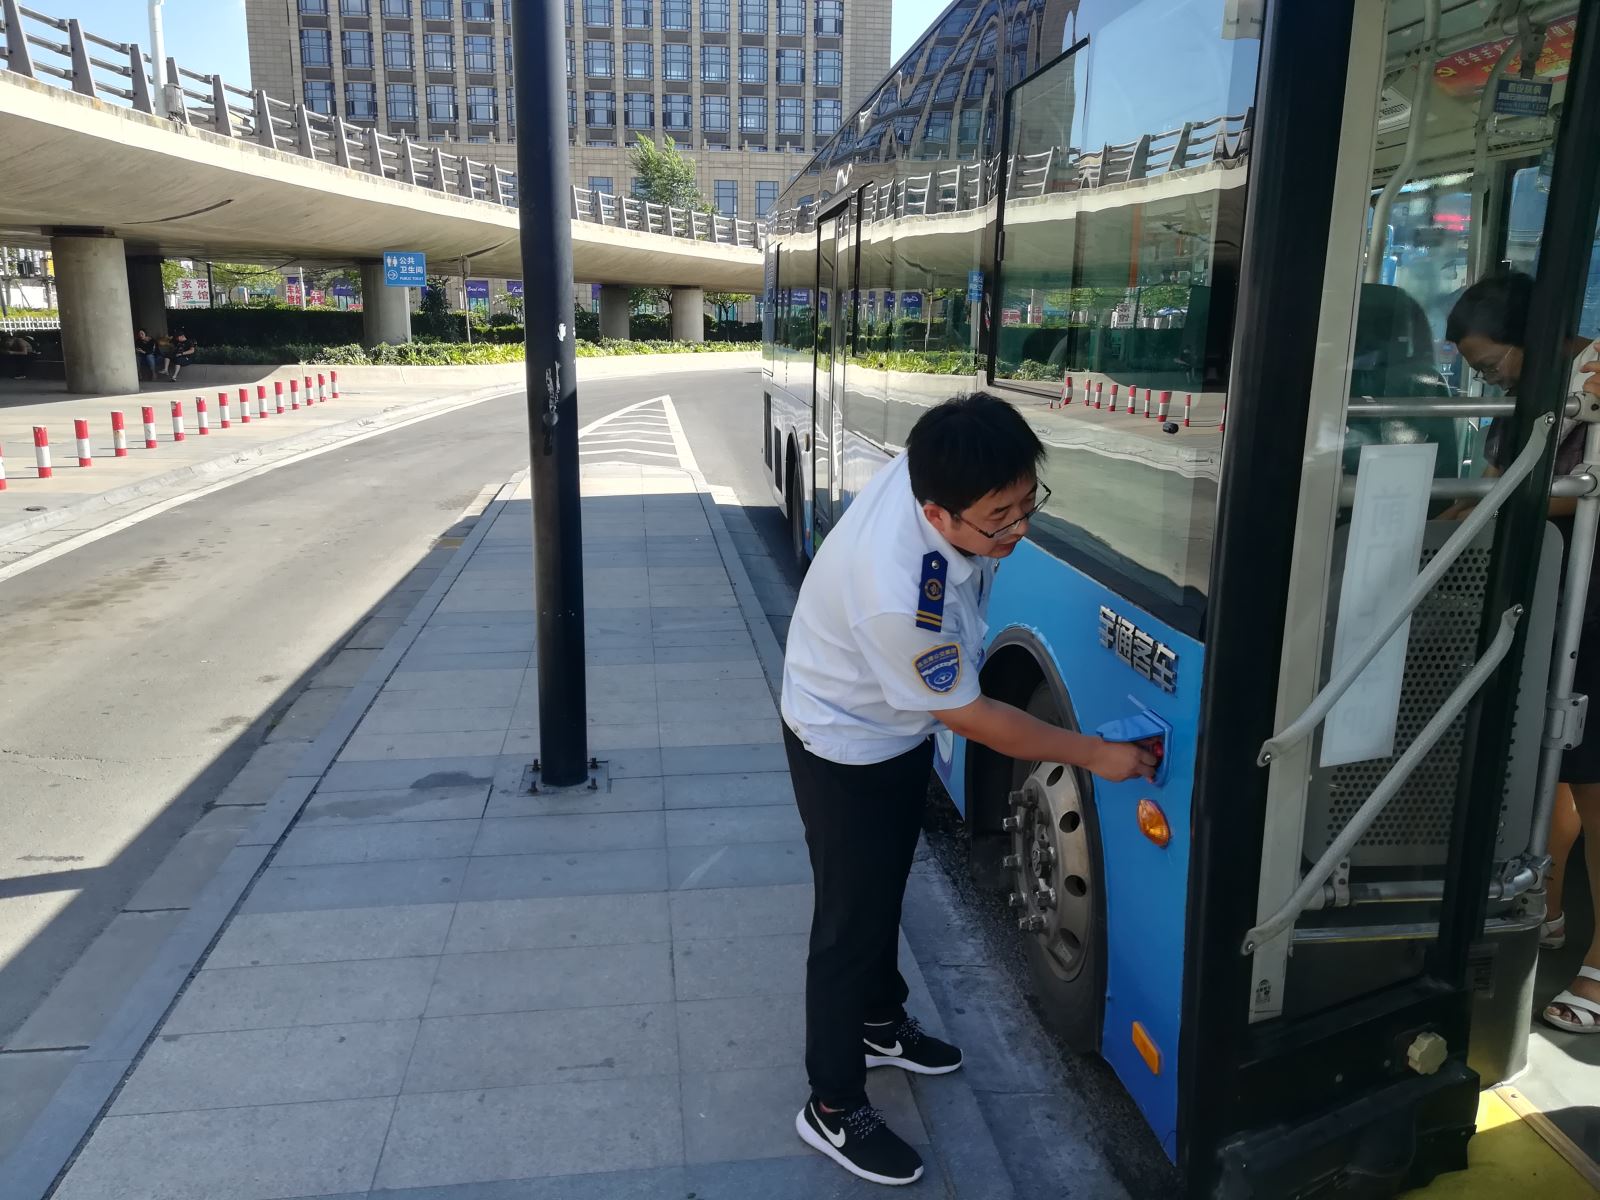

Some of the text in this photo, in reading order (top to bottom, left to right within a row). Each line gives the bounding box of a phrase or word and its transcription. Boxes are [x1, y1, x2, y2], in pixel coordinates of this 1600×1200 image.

[399, 256, 415, 265] 公共
[399, 266, 424, 274] 卫生间
[182, 279, 208, 289] 家常
[182, 290, 209, 300] 菜馆
[1098, 604, 1177, 694] 宇通客车
